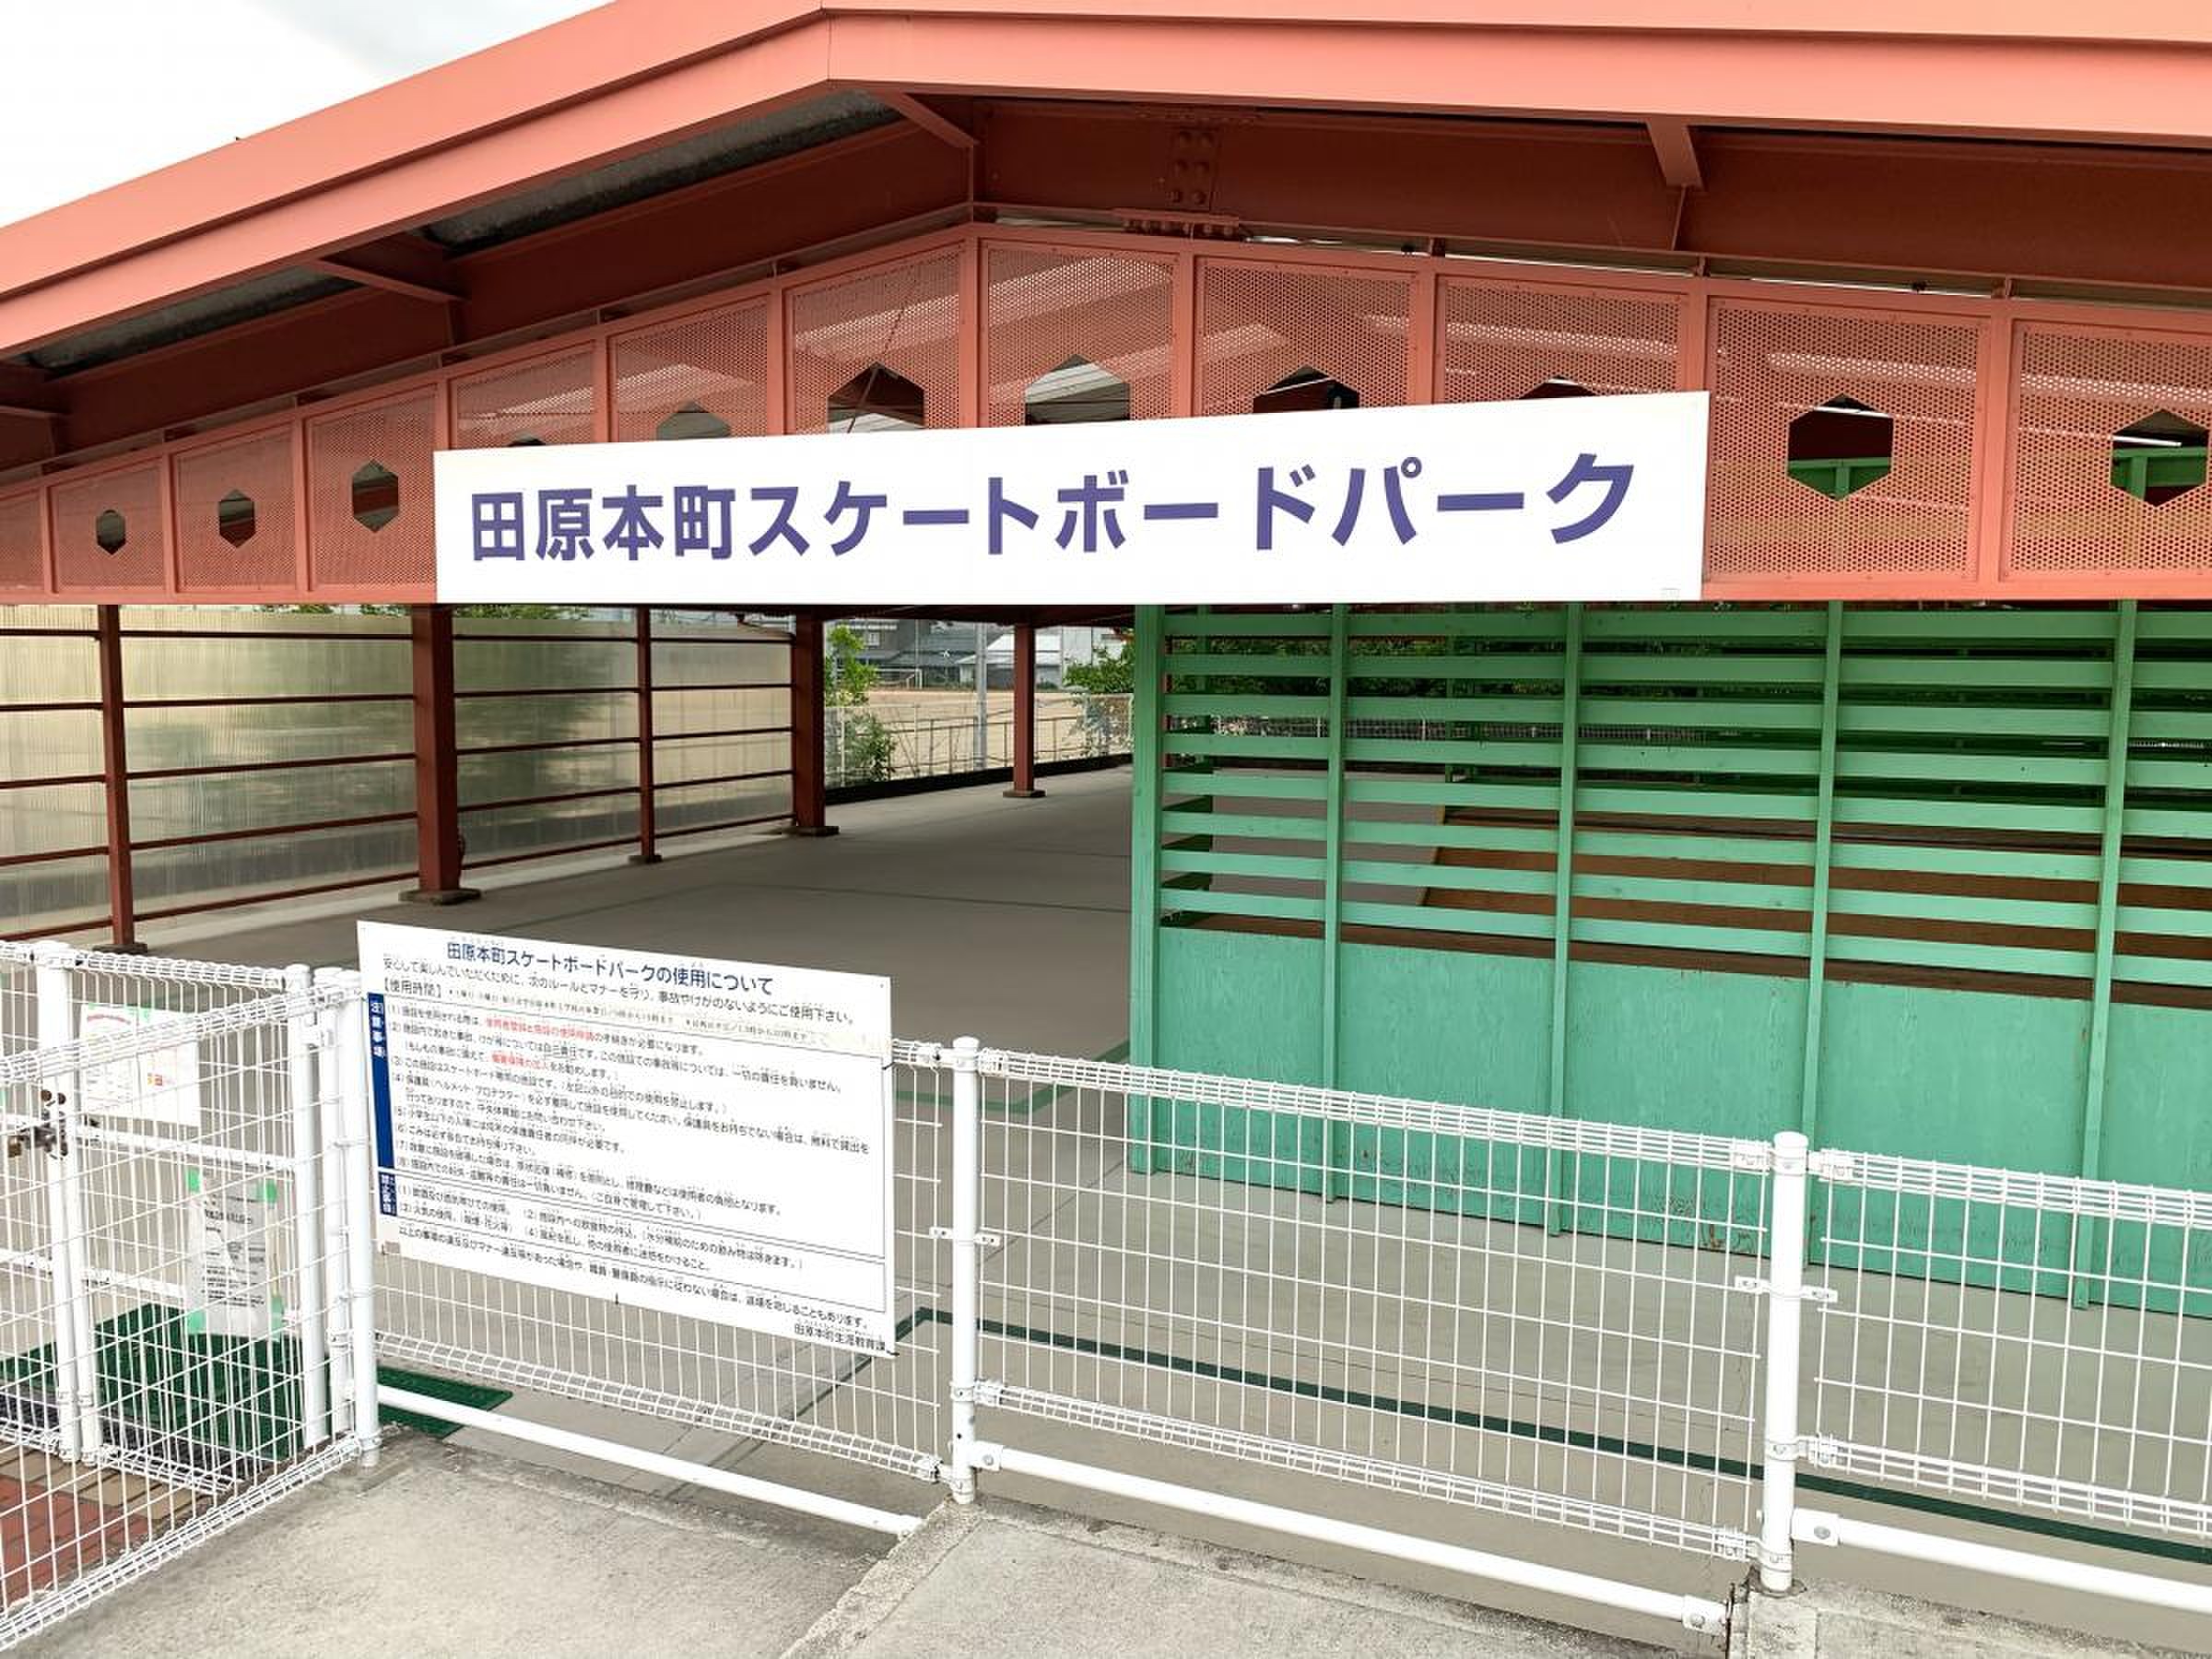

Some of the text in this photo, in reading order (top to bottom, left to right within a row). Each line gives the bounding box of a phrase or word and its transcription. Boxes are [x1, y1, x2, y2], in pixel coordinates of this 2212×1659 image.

[471, 452, 1635, 561] 田原本町スケートボードパーク
[447, 942, 773, 995] 田原本町スケートボードパークの使用について
